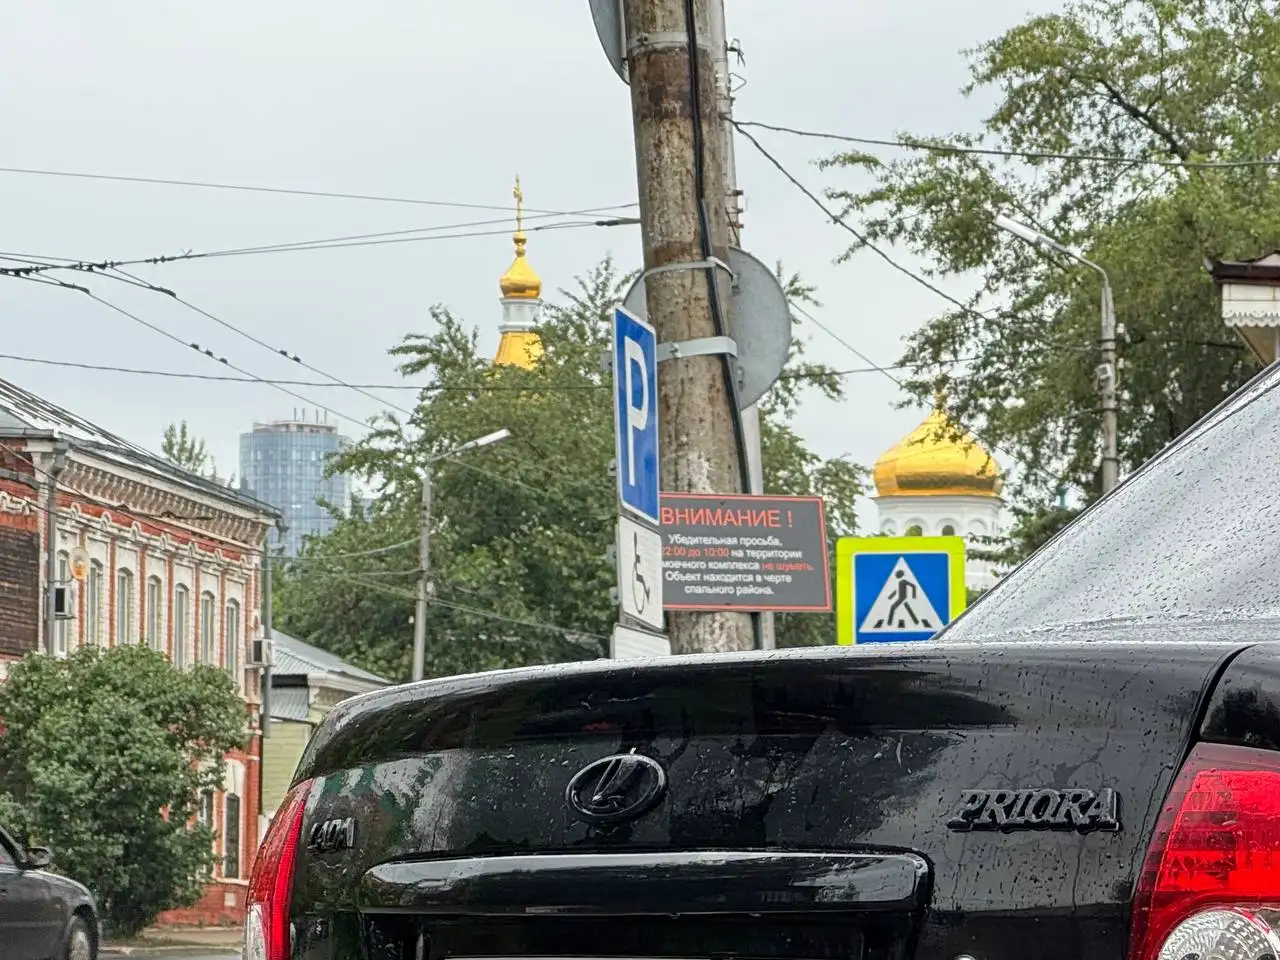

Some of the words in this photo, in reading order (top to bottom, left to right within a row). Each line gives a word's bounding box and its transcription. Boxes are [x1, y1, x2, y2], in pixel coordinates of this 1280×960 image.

[624, 335, 649, 487] P
[661, 507, 781, 528] ВНИМАНИЕ
[668, 534, 738, 546] Убедительная
[739, 536, 783, 547] просьба,
[662, 546, 686, 556] 2:00
[687, 548, 701, 557] до
[703, 547, 729, 557] 10:00
[731, 549, 744, 557] на
[745, 550, 803, 560] территории
[708, 561, 760, 570] комплекса
[665, 571, 701, 581] Объект
[703, 573, 754, 583] находится
[755, 574, 762, 582] в
[764, 574, 793, 584] черте
[684, 585, 735, 594] спального
[947, 787, 1121, 833] PRIORA
